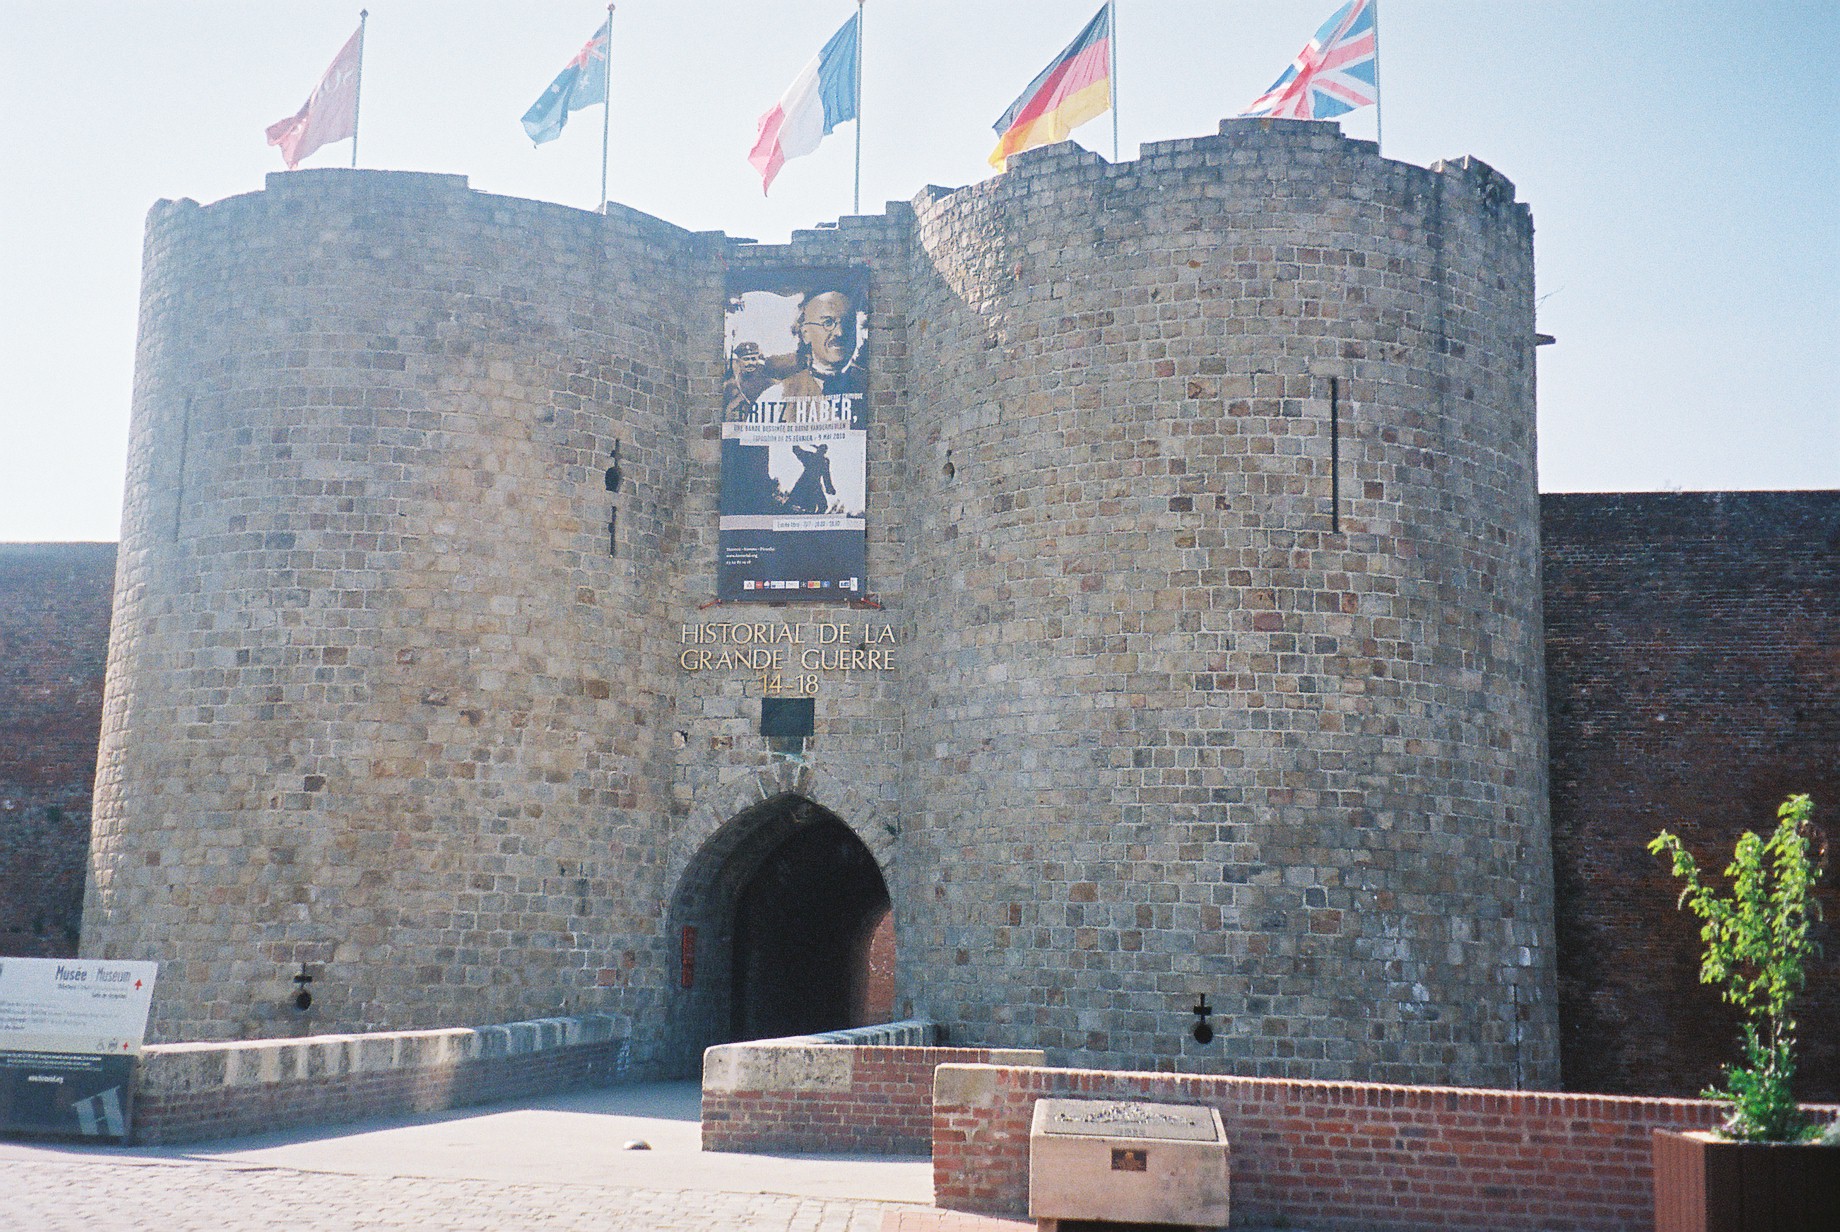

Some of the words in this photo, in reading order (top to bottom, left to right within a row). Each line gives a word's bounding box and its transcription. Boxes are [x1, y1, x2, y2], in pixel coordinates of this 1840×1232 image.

[795, 399, 857, 423] HABER,
[681, 623, 805, 645] HISTORIAL
[820, 623, 850, 645] DE
[864, 623, 896, 645] LA
[681, 649, 783, 671] GRANDE
[801, 649, 896, 671] GUERRE
[759, 673, 819, 695] 14-18
[55, 965, 87, 981] Musée
[95, 967, 131, 983] Museum
